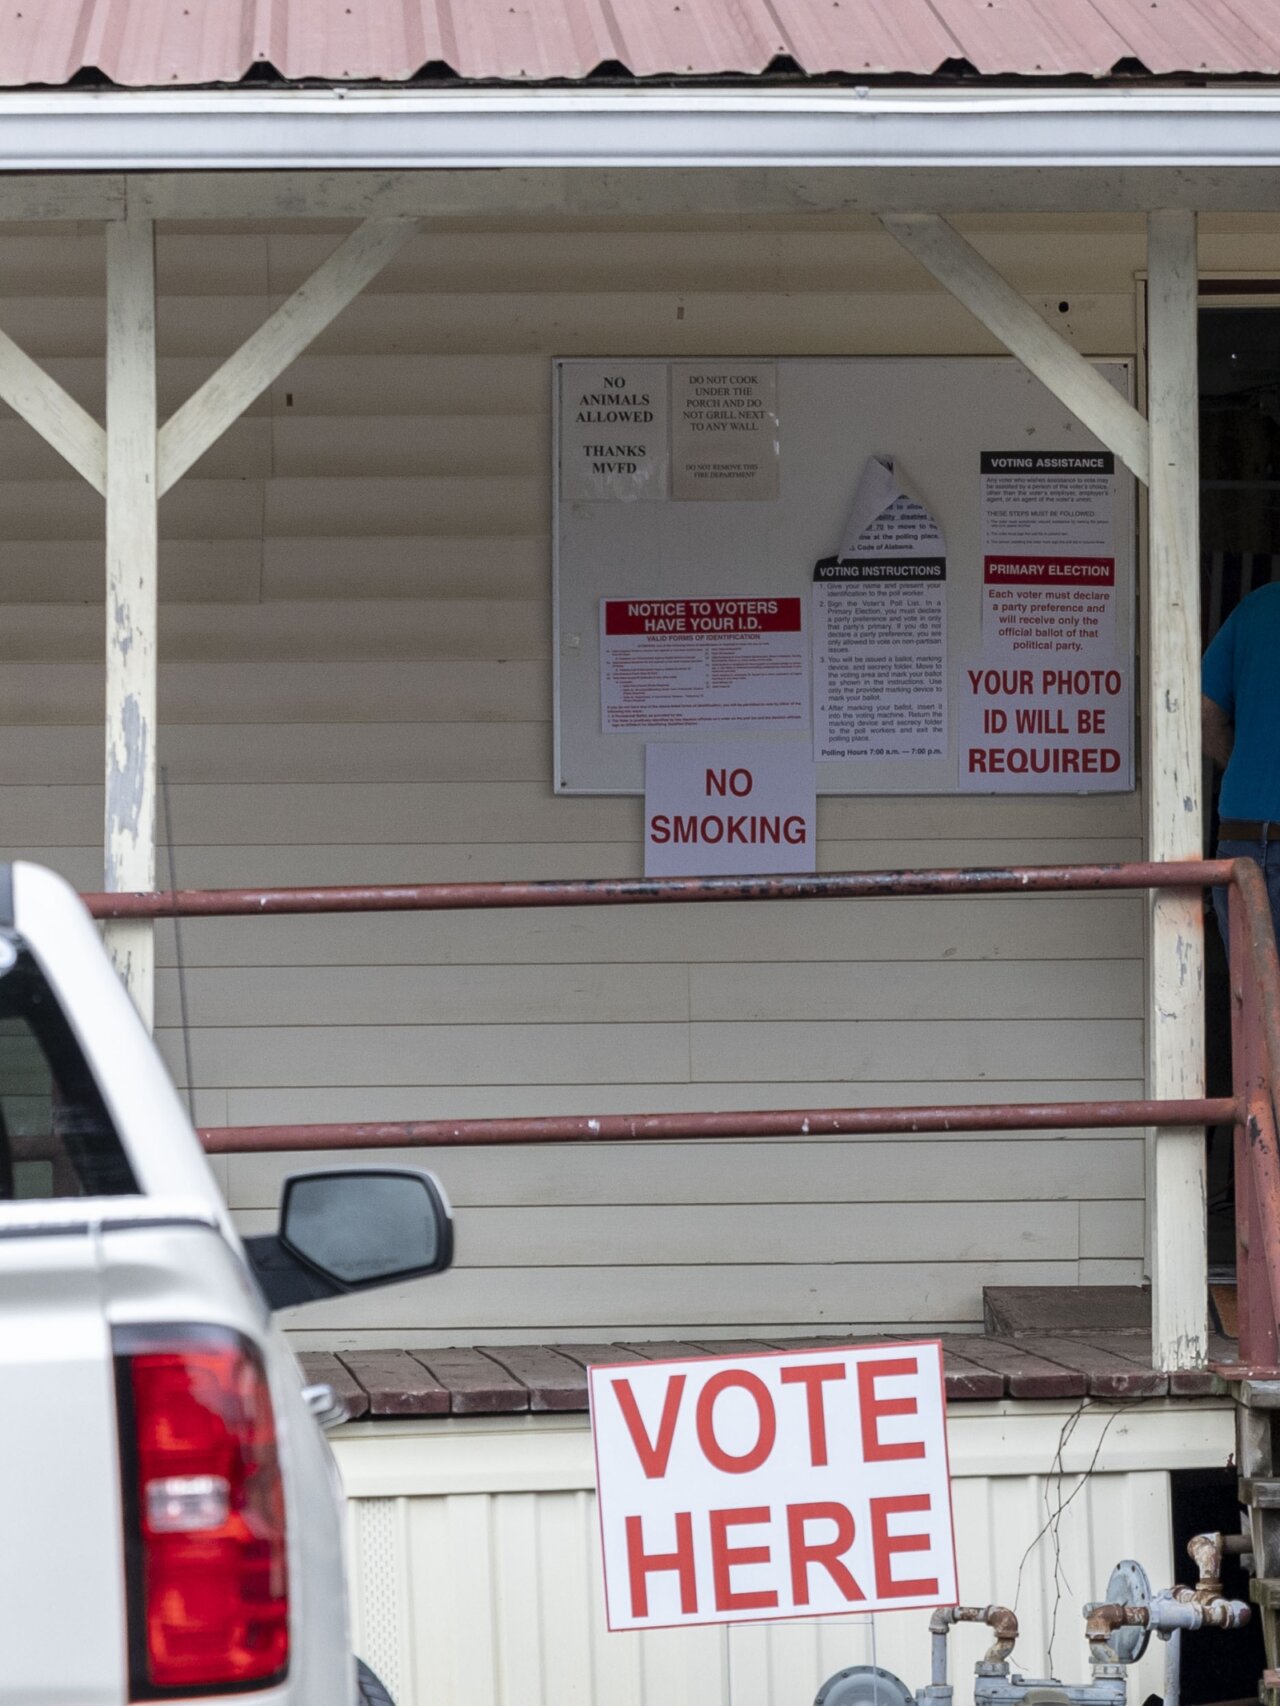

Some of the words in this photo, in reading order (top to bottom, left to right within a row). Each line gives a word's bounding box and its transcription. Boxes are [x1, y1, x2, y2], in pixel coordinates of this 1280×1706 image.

[604, 377, 625, 388] NO
[689, 376, 704, 384] DO
[707, 376, 727, 384] NOT
[729, 376, 759, 384] COOK
[696, 387, 730, 396] UNDER
[734, 387, 752, 396] THE
[579, 394, 650, 406] ANIMALS
[686, 399, 720, 408] PORCH
[723, 399, 744, 408] AND
[747, 399, 762, 408] DO
[576, 411, 653, 422] ALLOWED
[683, 411, 704, 419] NOT
[706, 411, 736, 419] GRILL
[738, 411, 766, 419] NEXT
[690, 423, 704, 431] TO
[706, 423, 727, 431] ANY
[730, 423, 758, 431] WALL
[583, 445, 646, 457] THANKS
[592, 462, 637, 474] MVFD
[991, 458, 1033, 468] VOTING
[1036, 458, 1104, 468] ASSISTANCE
[820, 567, 859, 576] VOTING
[862, 566, 941, 575] INSTRUCTIONS
[989, 564, 1044, 575] PRIMARY
[1048, 565, 1109, 576] ELECTION
[989, 589, 1013, 599] Each
[1017, 591, 1042, 599] voter
[1045, 591, 1070, 599] must
[1073, 591, 1110, 600] declare
[628, 604, 686, 616] NOTICE
[692, 603, 711, 615] TO
[716, 602, 778, 615] VOTERS
[993, 604, 999, 612] a
[1002, 603, 1027, 615] party
[1030, 603, 1084, 615] preference
[1087, 604, 1105, 613] and
[644, 618, 687, 631] HAVE
[690, 618, 734, 630] YOUR
[738, 617, 763, 630] I.D.
[999, 616, 1016, 624] will
[1019, 616, 1055, 624] receive
[1058, 616, 1079, 627] only
[1082, 616, 1098, 625] the
[998, 628, 1032, 637] official
[1036, 628, 1064, 637] ballot
[1067, 628, 1076, 637] of
[1079, 629, 1099, 638] that
[1013, 640, 1052, 652] political
[1056, 641, 1083, 652] party.
[967, 670, 1033, 695] YOUR
[1043, 670, 1121, 695] PHOTO
[984, 709, 1007, 734] ID
[1016, 709, 1069, 734] WILL
[1078, 709, 1106, 734] BE
[968, 749, 1121, 773] REQUIRED
[706, 768, 753, 797] NO
[650, 815, 806, 844] SMOKING
[611, 1357, 925, 1479] VOTE
[625, 1494, 939, 1618] HERE
